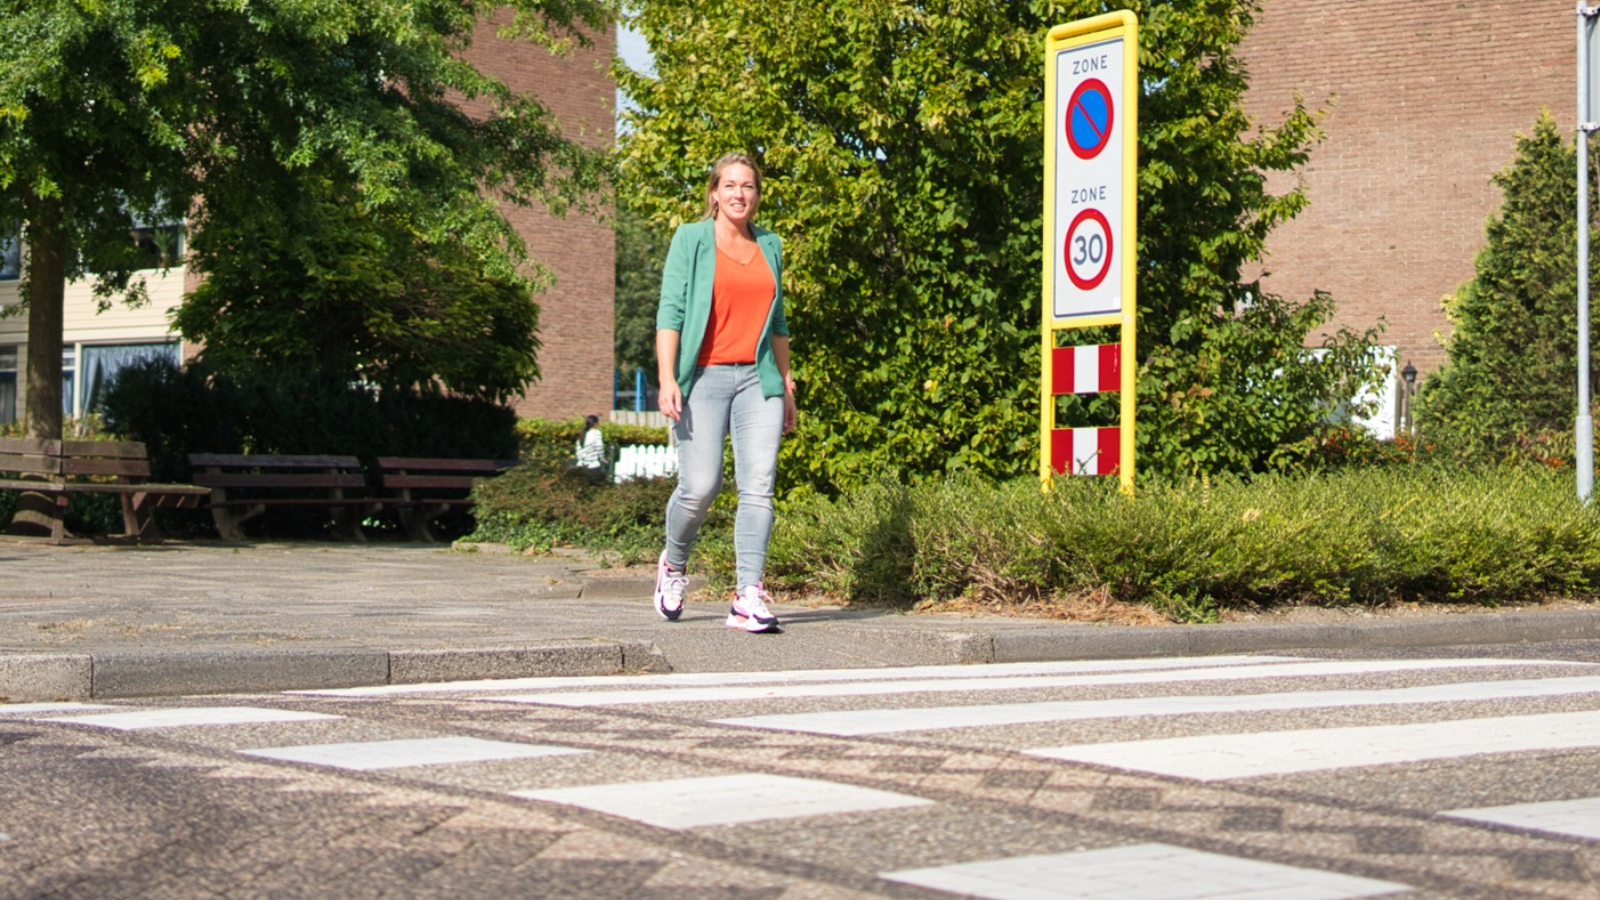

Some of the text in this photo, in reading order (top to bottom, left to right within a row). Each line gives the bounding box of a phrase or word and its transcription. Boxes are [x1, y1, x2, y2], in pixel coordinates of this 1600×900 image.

[1072, 55, 1108, 75] ZONE
[1071, 186, 1107, 204] ZONE
[1073, 233, 1103, 265] 30
